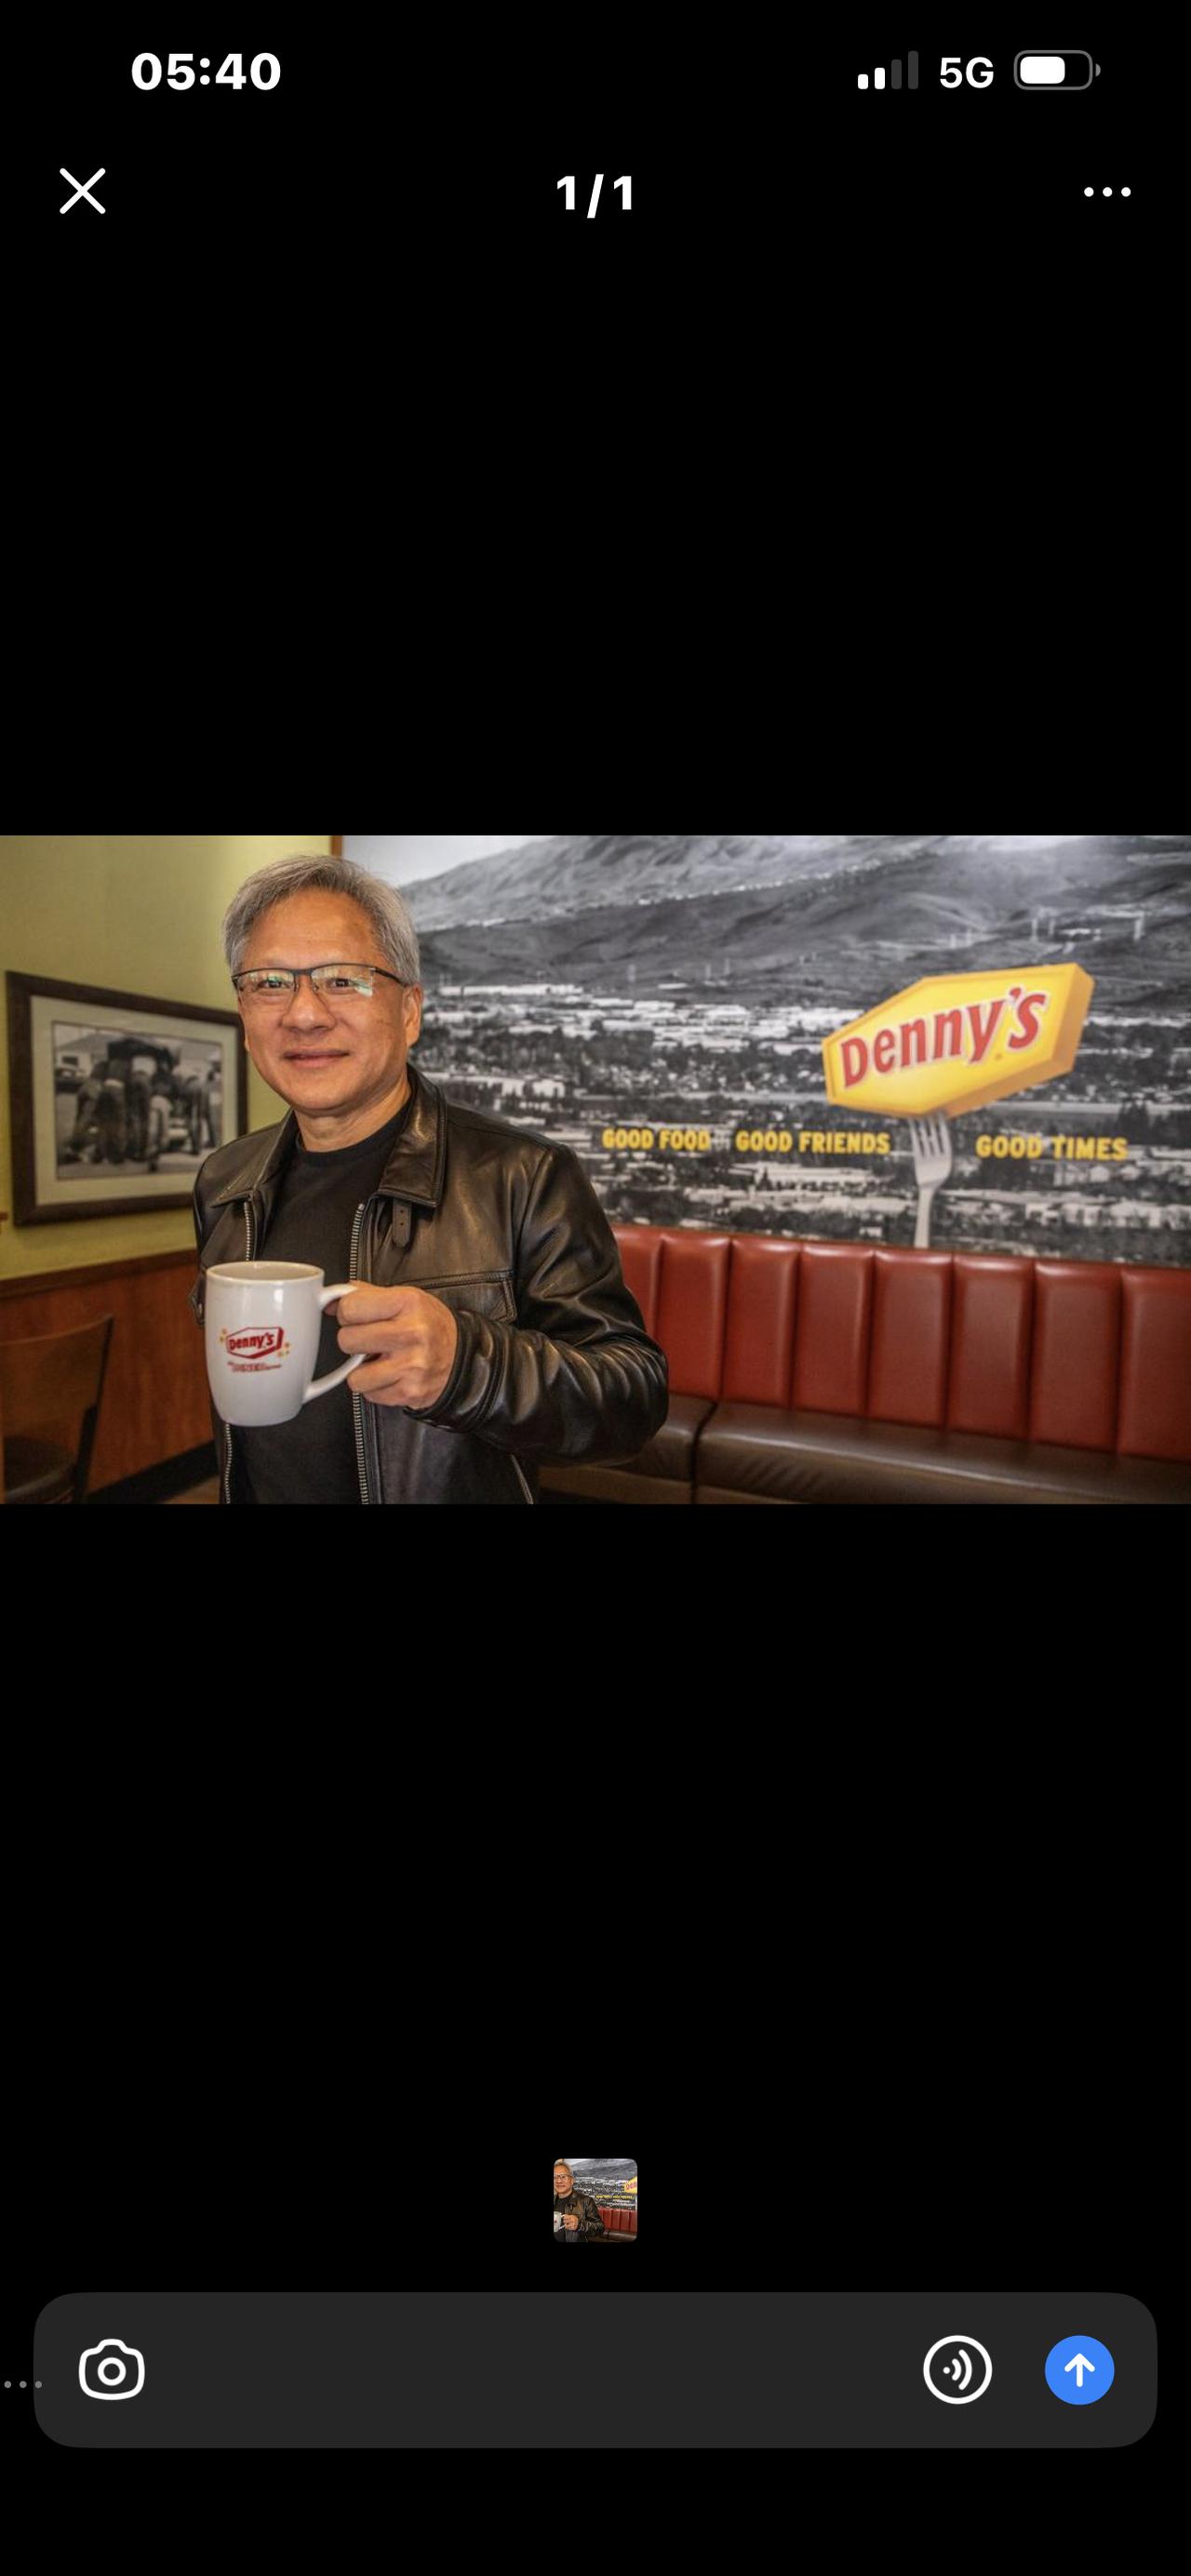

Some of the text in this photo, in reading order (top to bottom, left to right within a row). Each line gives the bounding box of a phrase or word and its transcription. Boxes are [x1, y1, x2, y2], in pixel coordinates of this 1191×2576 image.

[840, 987, 1046, 1088] Denny's
[601, 1128, 1128, 1161] GOOD FOOD GOOD FRIENDS GOOD TIMES
[229, 1332, 274, 1350] Denny's
